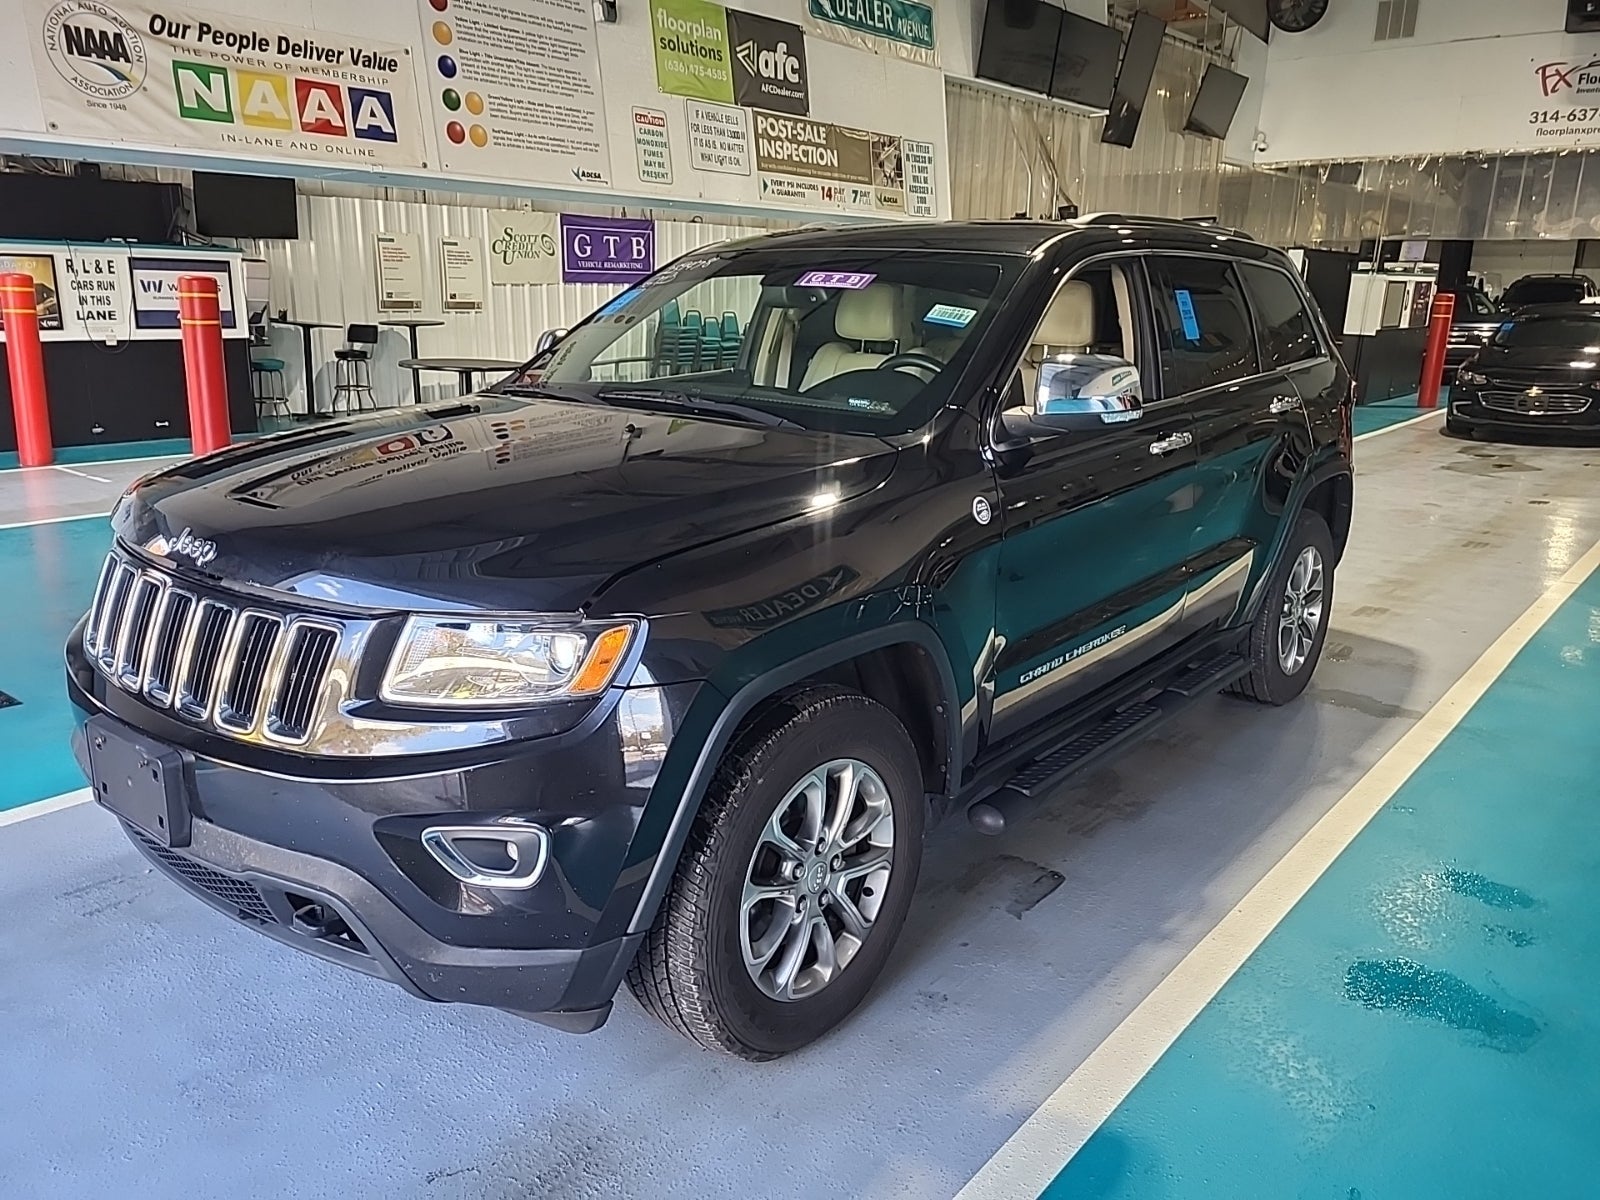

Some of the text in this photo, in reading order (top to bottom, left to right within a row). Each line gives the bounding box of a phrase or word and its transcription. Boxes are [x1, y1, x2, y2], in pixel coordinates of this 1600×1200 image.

[656, 7, 722, 42] floorplan
[836, 0, 929, 41] DEALER AVENUE
[46, 2, 144, 63] NATIONAL AUTO AUCTION
[62, 23, 132, 64] NAAA
[149, 13, 399, 73] Our People Deliver Value
[659, 34, 723, 62] solutions
[171, 44, 390, 85] THE POWER OF MEMBERSHIP
[664, 59, 688, 76] (636)
[758, 42, 800, 84] afc
[71, 76, 134, 97] ASSOCIATION
[1578, 72, 1600, 86] Flo
[761, 84, 804, 99] AFCDealer.com
[86, 99, 108, 110] Since
[636, 113, 664, 126] CAUTION
[695, 109, 738, 126] IF A VEHICLE SELLS
[1529, 107, 1600, 125] 314-637
[638, 127, 664, 138] CARBON
[691, 122, 701, 133] FOR
[701, 124, 713, 135] LESS
[713, 126, 726, 137] THAN
[756, 115, 827, 145] POST-SALE
[221, 132, 376, 158] IN-LANE AND ONLINE
[636, 137, 668, 149] MONOXIDE
[694, 137, 699, 147] IT
[699, 138, 704, 147] IS
[705, 139, 712, 149] AS
[720, 142, 727, 152] NO
[727, 142, 744, 154] MATTER
[643, 149, 664, 159] FUMES
[700, 153, 713, 163] WHAT
[714, 154, 727, 166] LIGHT
[728, 156, 733, 166] IS
[758, 137, 839, 168] INSPECTION
[643, 159, 666, 169] MAY BE
[642, 169, 668, 180] PRESENT
[770, 179, 819, 192] EVERY PSI INCLUDES
[776, 188, 806, 199] GUARANTEE
[833, 187, 845, 196] DAY
[820, 186, 833, 202] 14
[852, 189, 859, 204] 7
[859, 190, 871, 198] DAY
[503, 227, 540, 242] SCOTT
[491, 239, 535, 256] CREDIT
[502, 250, 541, 266] UNION
[577, 260, 643, 270] VEHICLE REMARKETING
[82, 258, 90, 274] L
[94, 259, 103, 274] &
[108, 260, 116, 275] E
[70, 279, 115, 292] CARS RUN
[78, 295, 111, 306] IN THIS
[76, 310, 118, 321] LANE
[169, 527, 218, 567] Jeep
[1019, 624, 1128, 685] GRAND CHEROKEE
